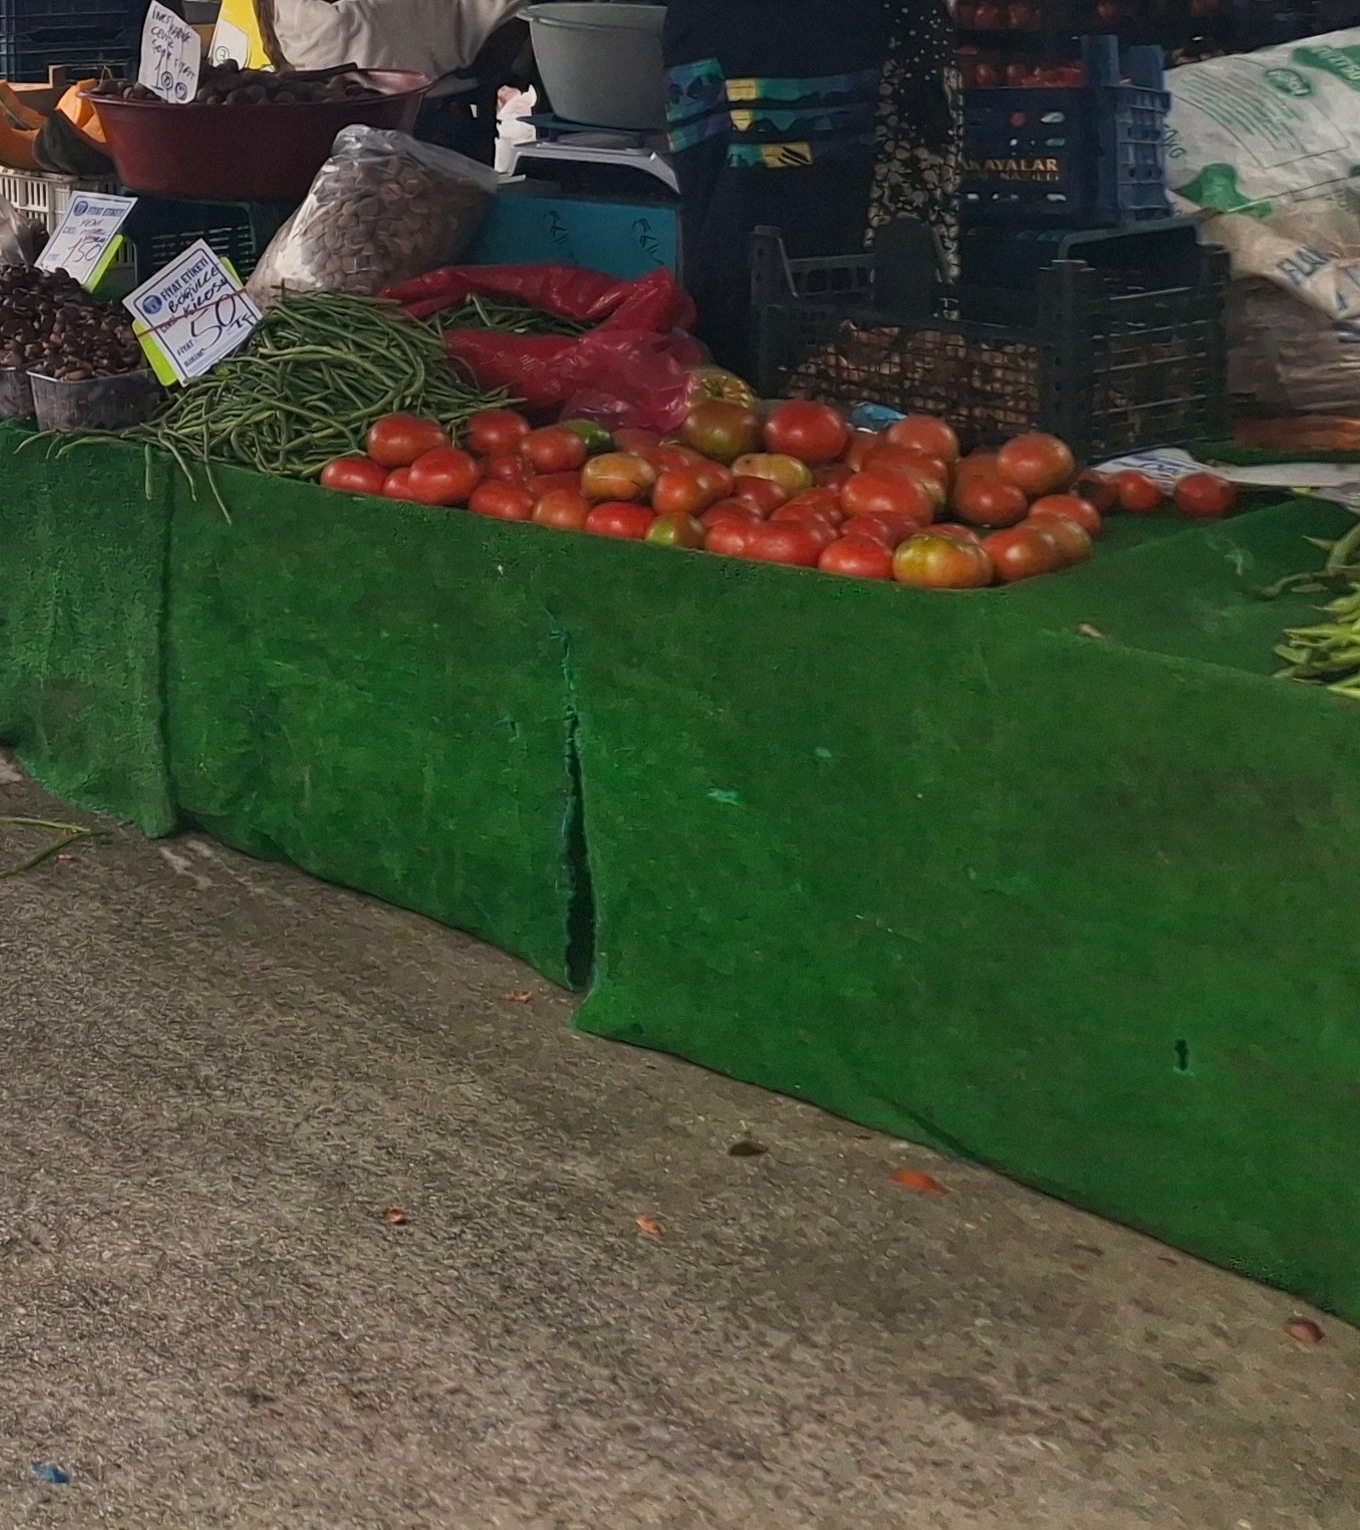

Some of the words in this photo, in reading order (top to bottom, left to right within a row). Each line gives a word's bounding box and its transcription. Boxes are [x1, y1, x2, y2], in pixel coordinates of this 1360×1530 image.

[161, 280, 184, 302] FİYAT
[180, 256, 211, 286] ETİKETİ
[190, 293, 236, 352] 50
